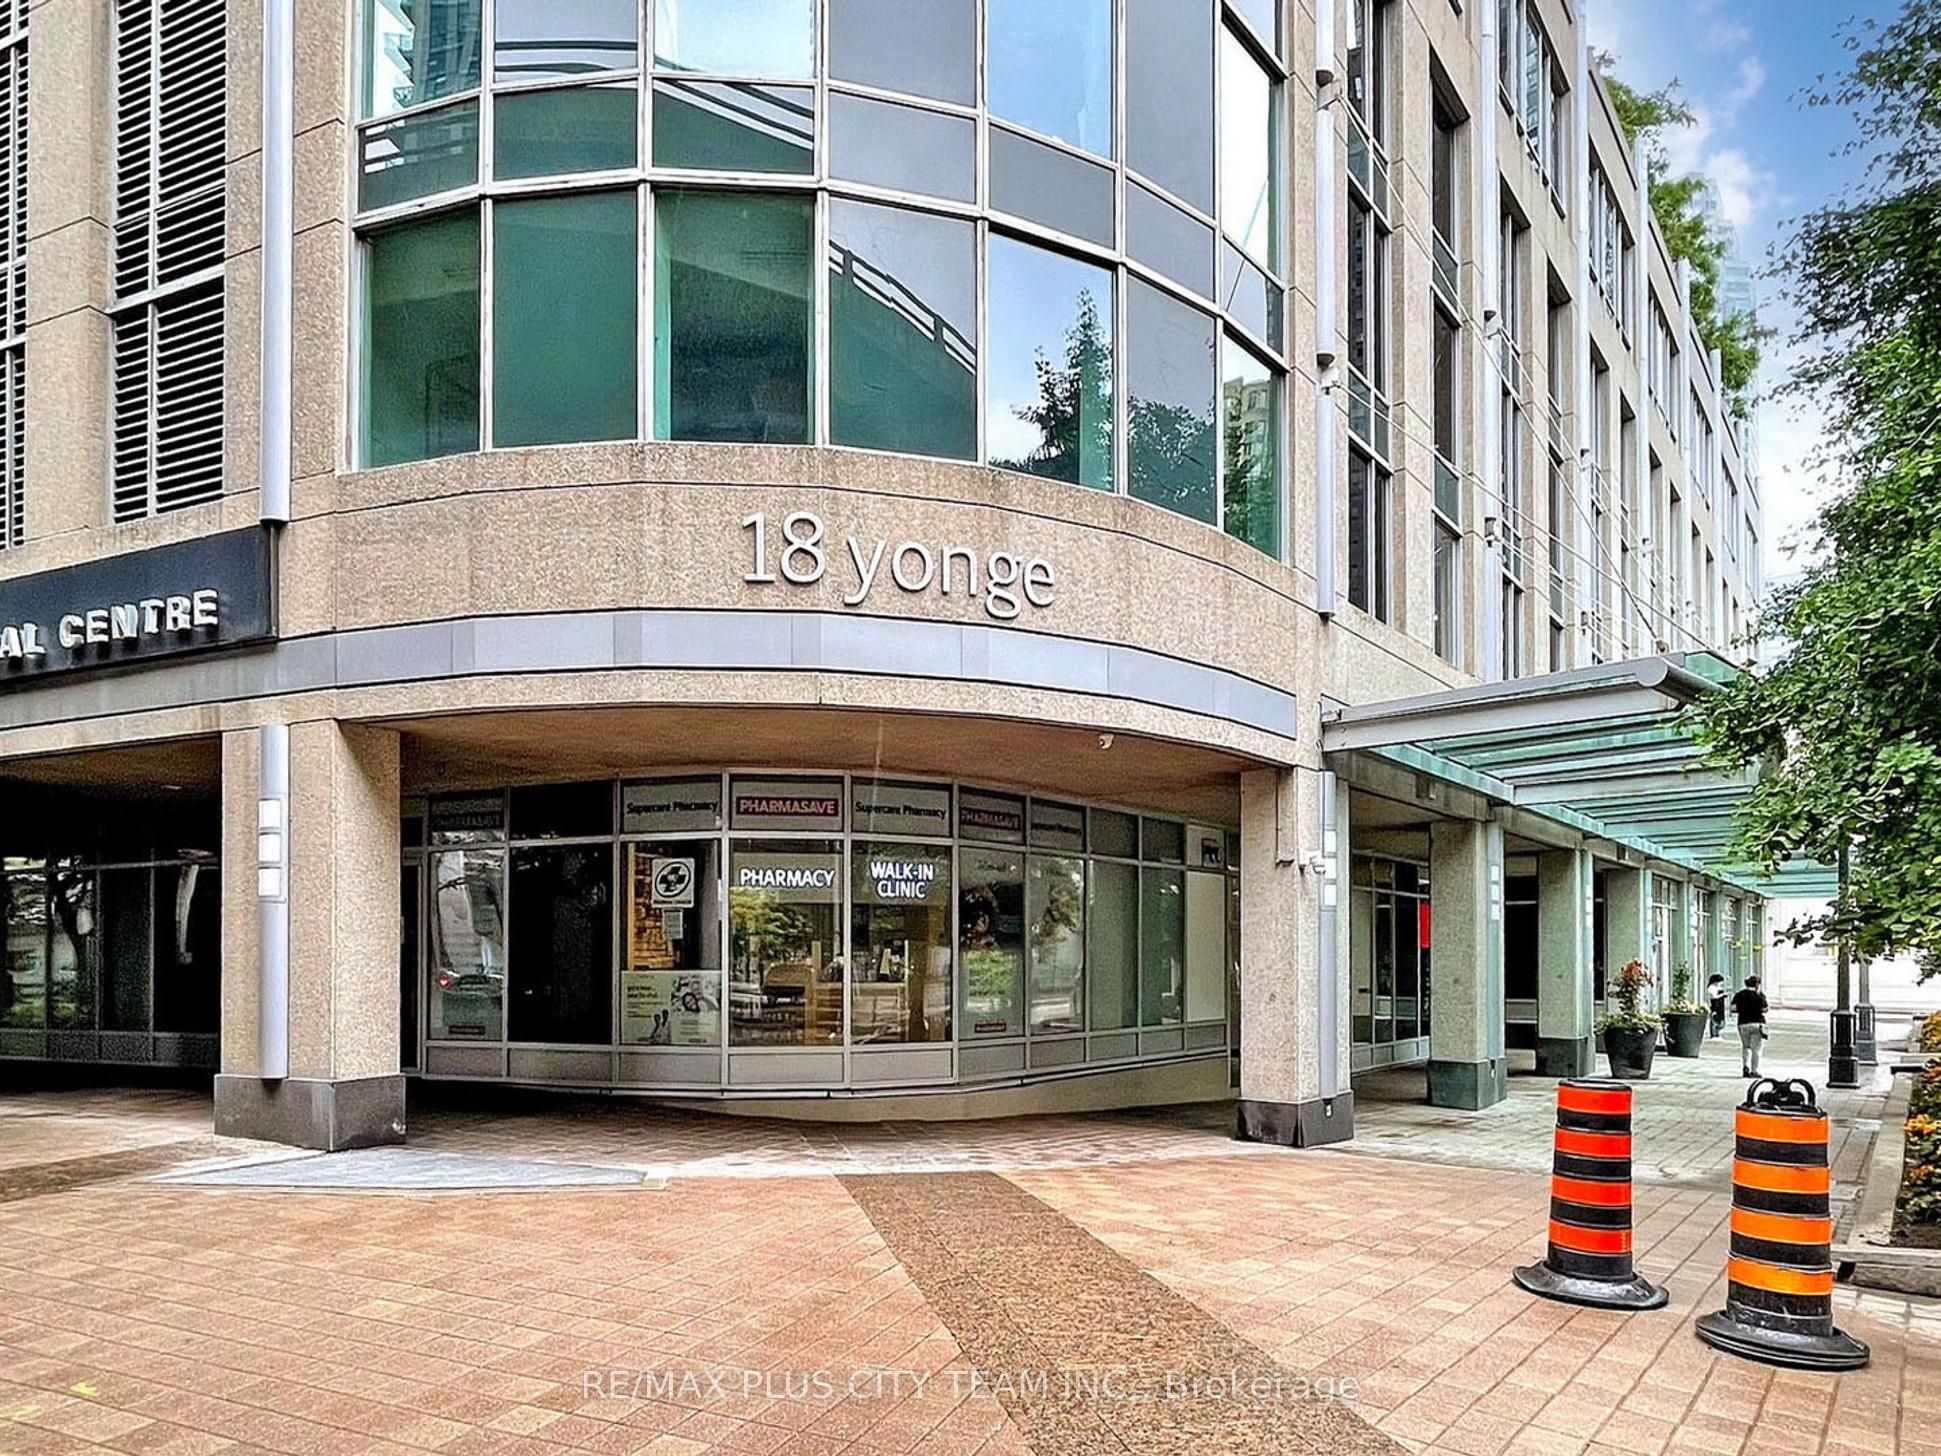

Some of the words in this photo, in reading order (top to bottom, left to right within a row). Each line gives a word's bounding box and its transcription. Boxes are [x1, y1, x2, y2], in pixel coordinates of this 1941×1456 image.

[742, 510, 827, 584] 18
[843, 535, 1057, 619] yonge
[58, 588, 219, 650] CENTRE
[740, 799, 835, 814] PHARMASAVE
[855, 801, 901, 816] Supercare
[903, 804, 947, 820] Pharmacy
[740, 868, 835, 888] PHARMACY
[870, 861, 935, 881] WALK-IN
[877, 880, 927, 898] CLINIC
